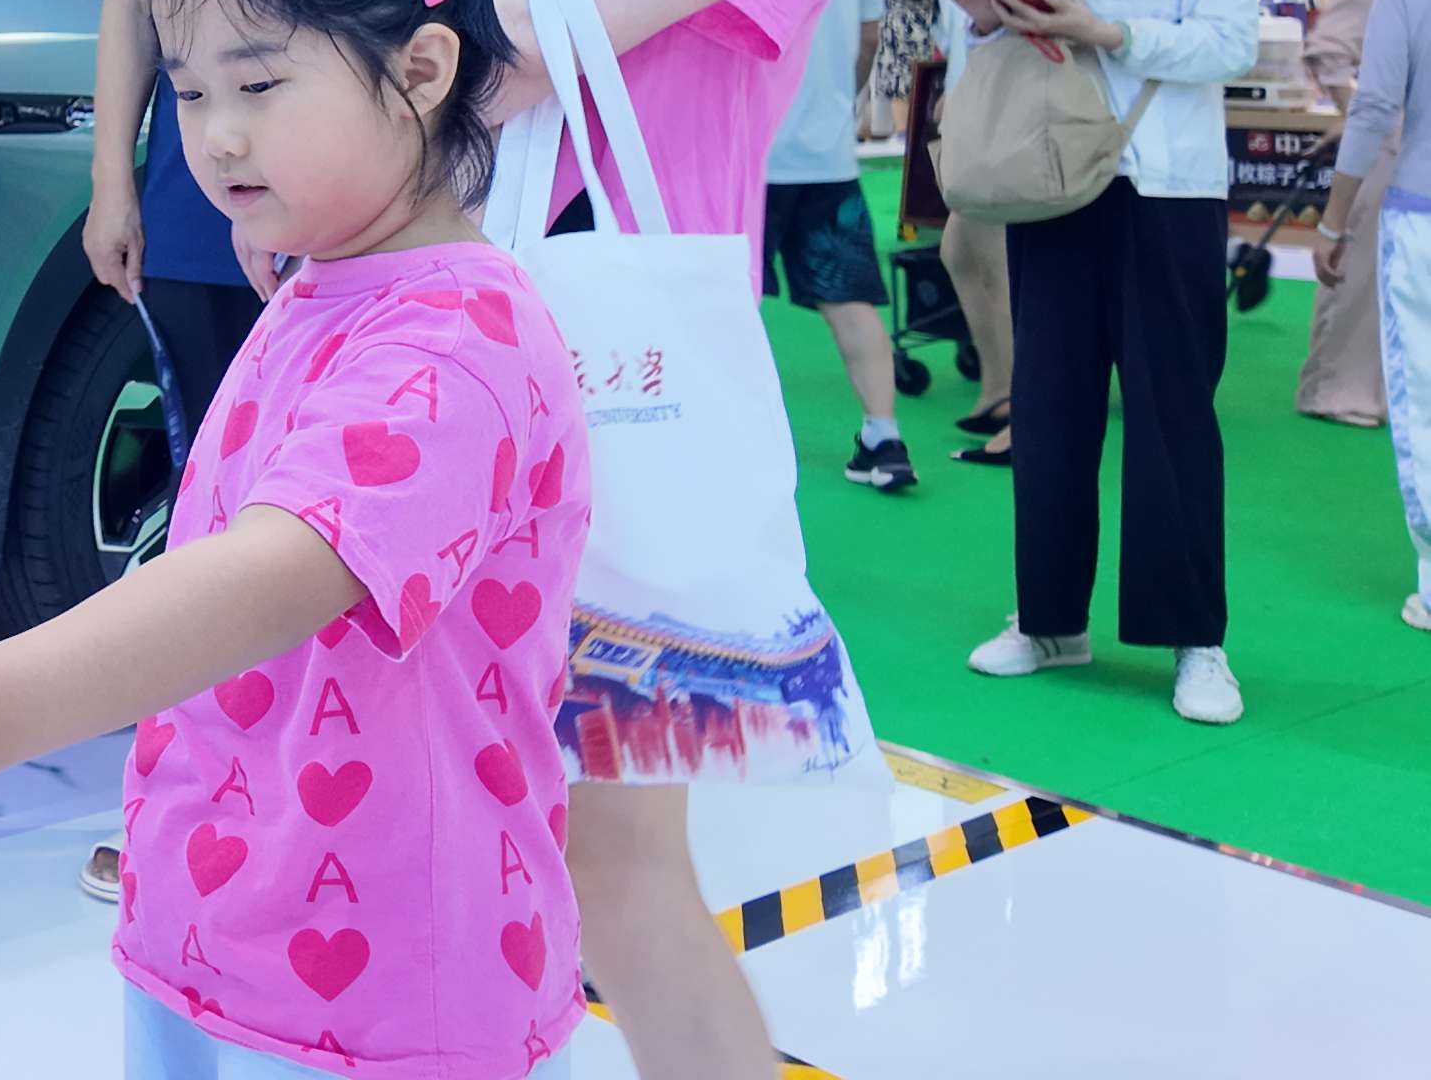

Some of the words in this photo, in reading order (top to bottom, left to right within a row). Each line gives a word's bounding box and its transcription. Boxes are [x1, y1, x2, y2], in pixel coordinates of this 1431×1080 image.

[386, 365, 438, 423] A
[525, 373, 550, 441] A
[209, 484, 228, 534] A
[297, 496, 343, 551] A
[437, 528, 479, 590] A
[309, 676, 362, 737] A
[475, 662, 509, 715] A
[211, 755, 256, 818] A
[304, 850, 361, 905] A
[499, 829, 534, 896] A
[181, 922, 223, 978] A
